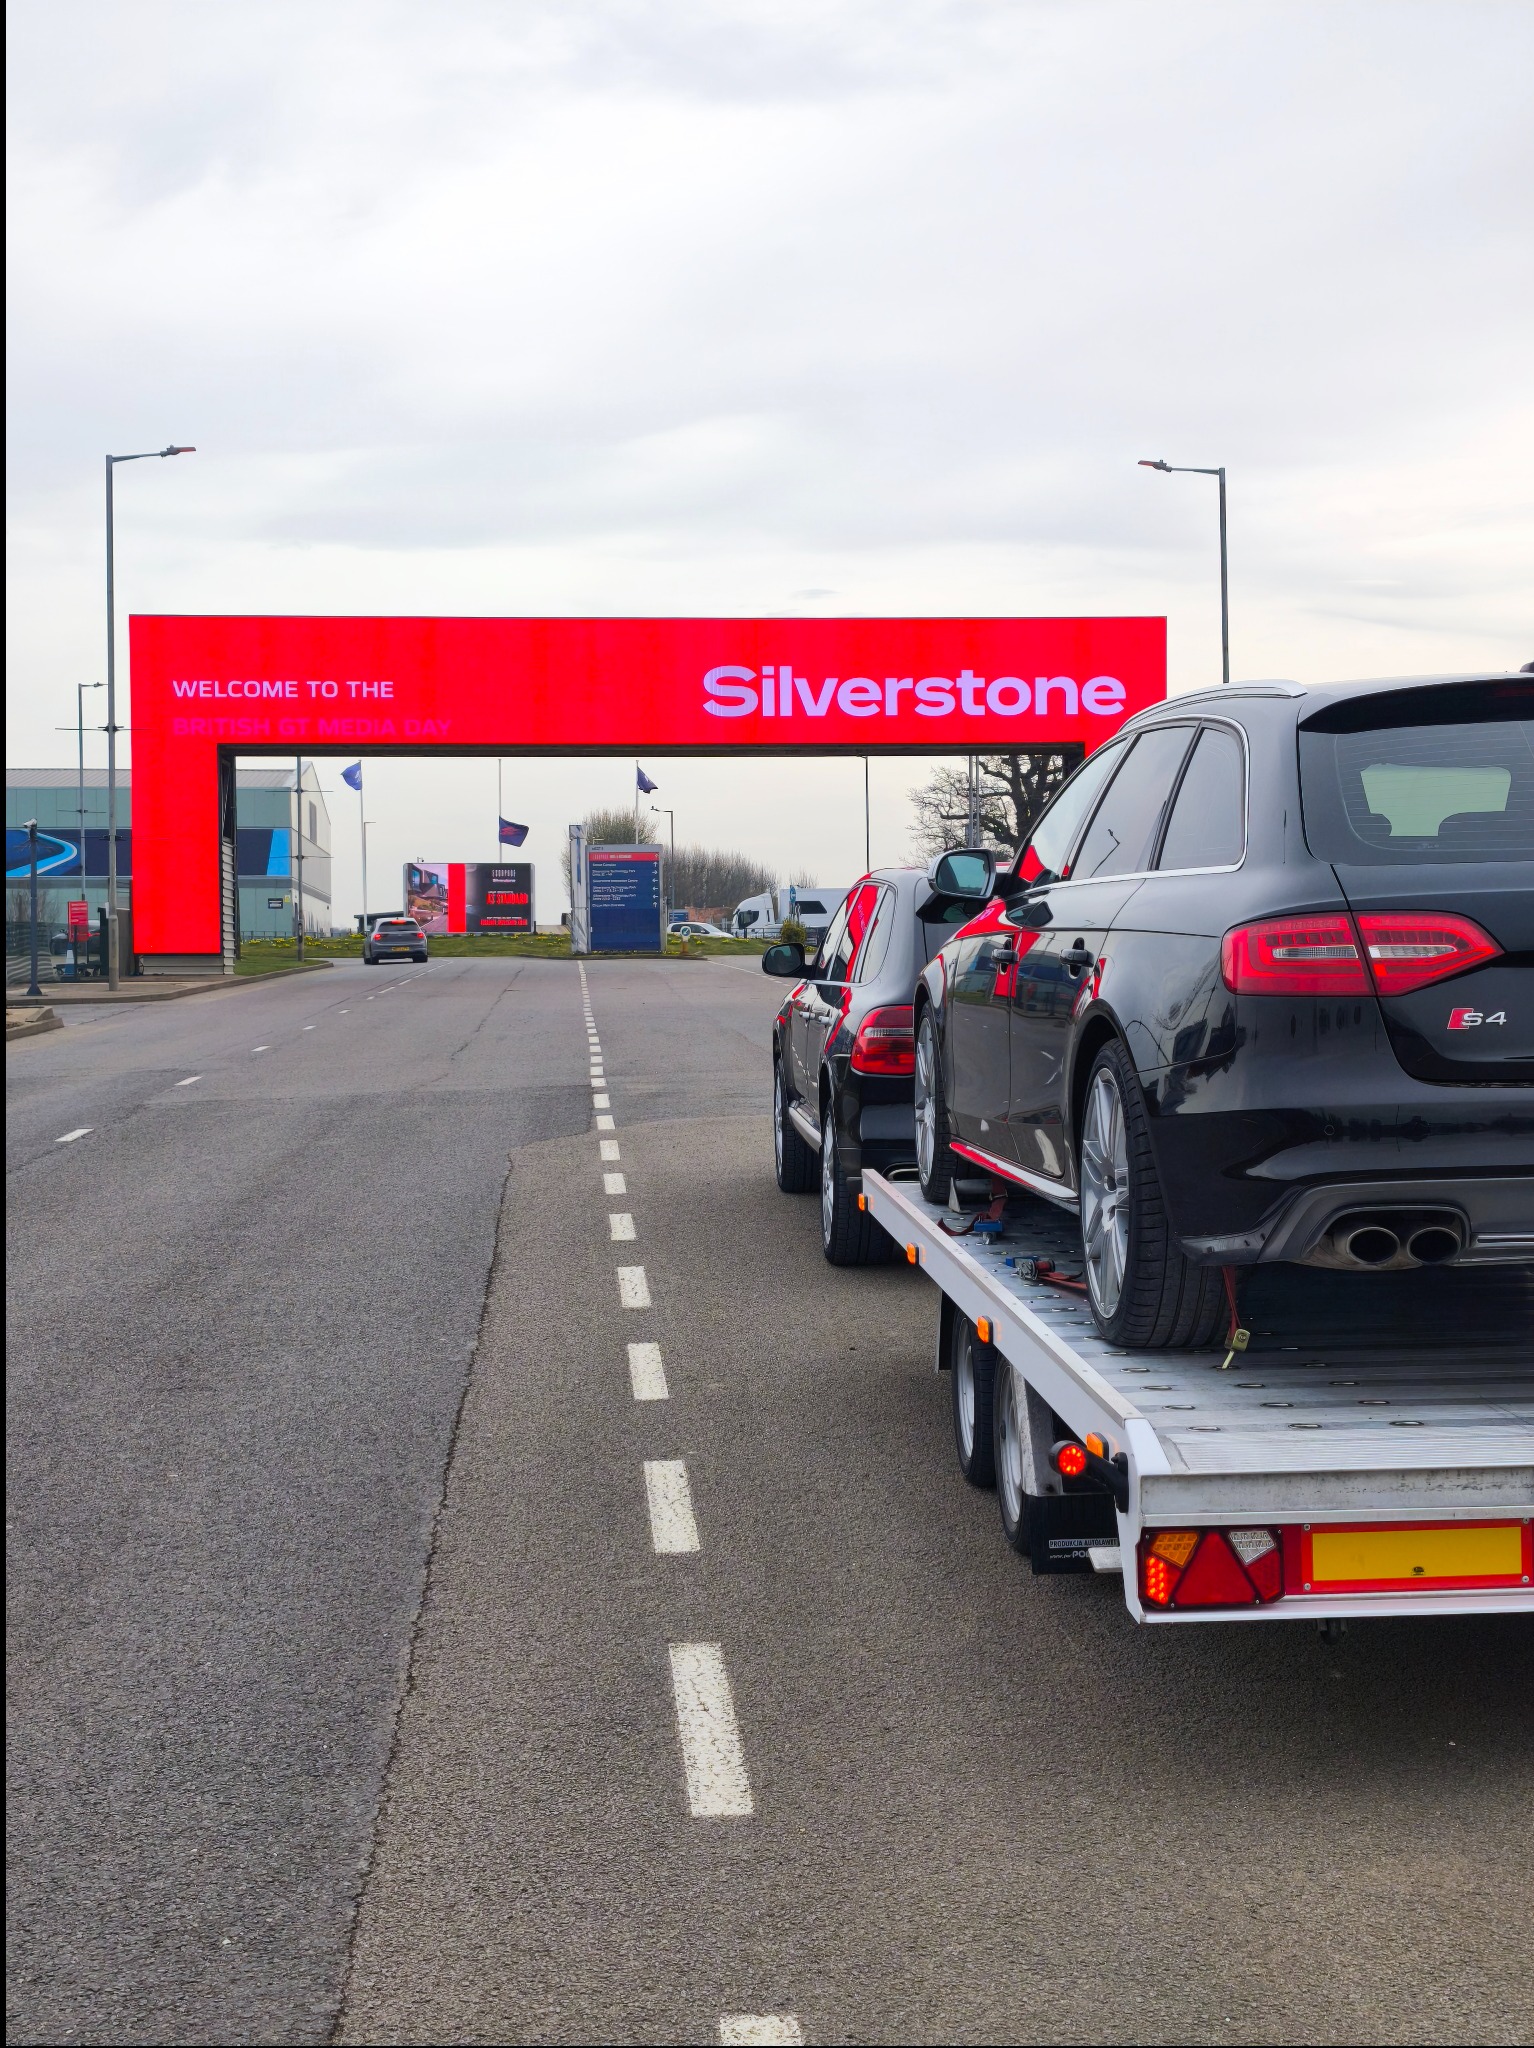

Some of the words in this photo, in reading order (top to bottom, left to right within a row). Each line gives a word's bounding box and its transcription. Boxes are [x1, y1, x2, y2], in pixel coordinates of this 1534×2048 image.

[172, 680, 298, 698] WELCOME
[306, 680, 339, 698] TO
[346, 681, 394, 698] THE
[702, 665, 1127, 717] Silverstone
[173, 717, 270, 736] BRITISH
[278, 718, 309, 736] GT
[318, 718, 397, 736] MEDIA
[404, 719, 452, 736] DAY
[1461, 1011, 1507, 1026] S4
[1049, 1540, 1083, 1548] PRODUKCJA
